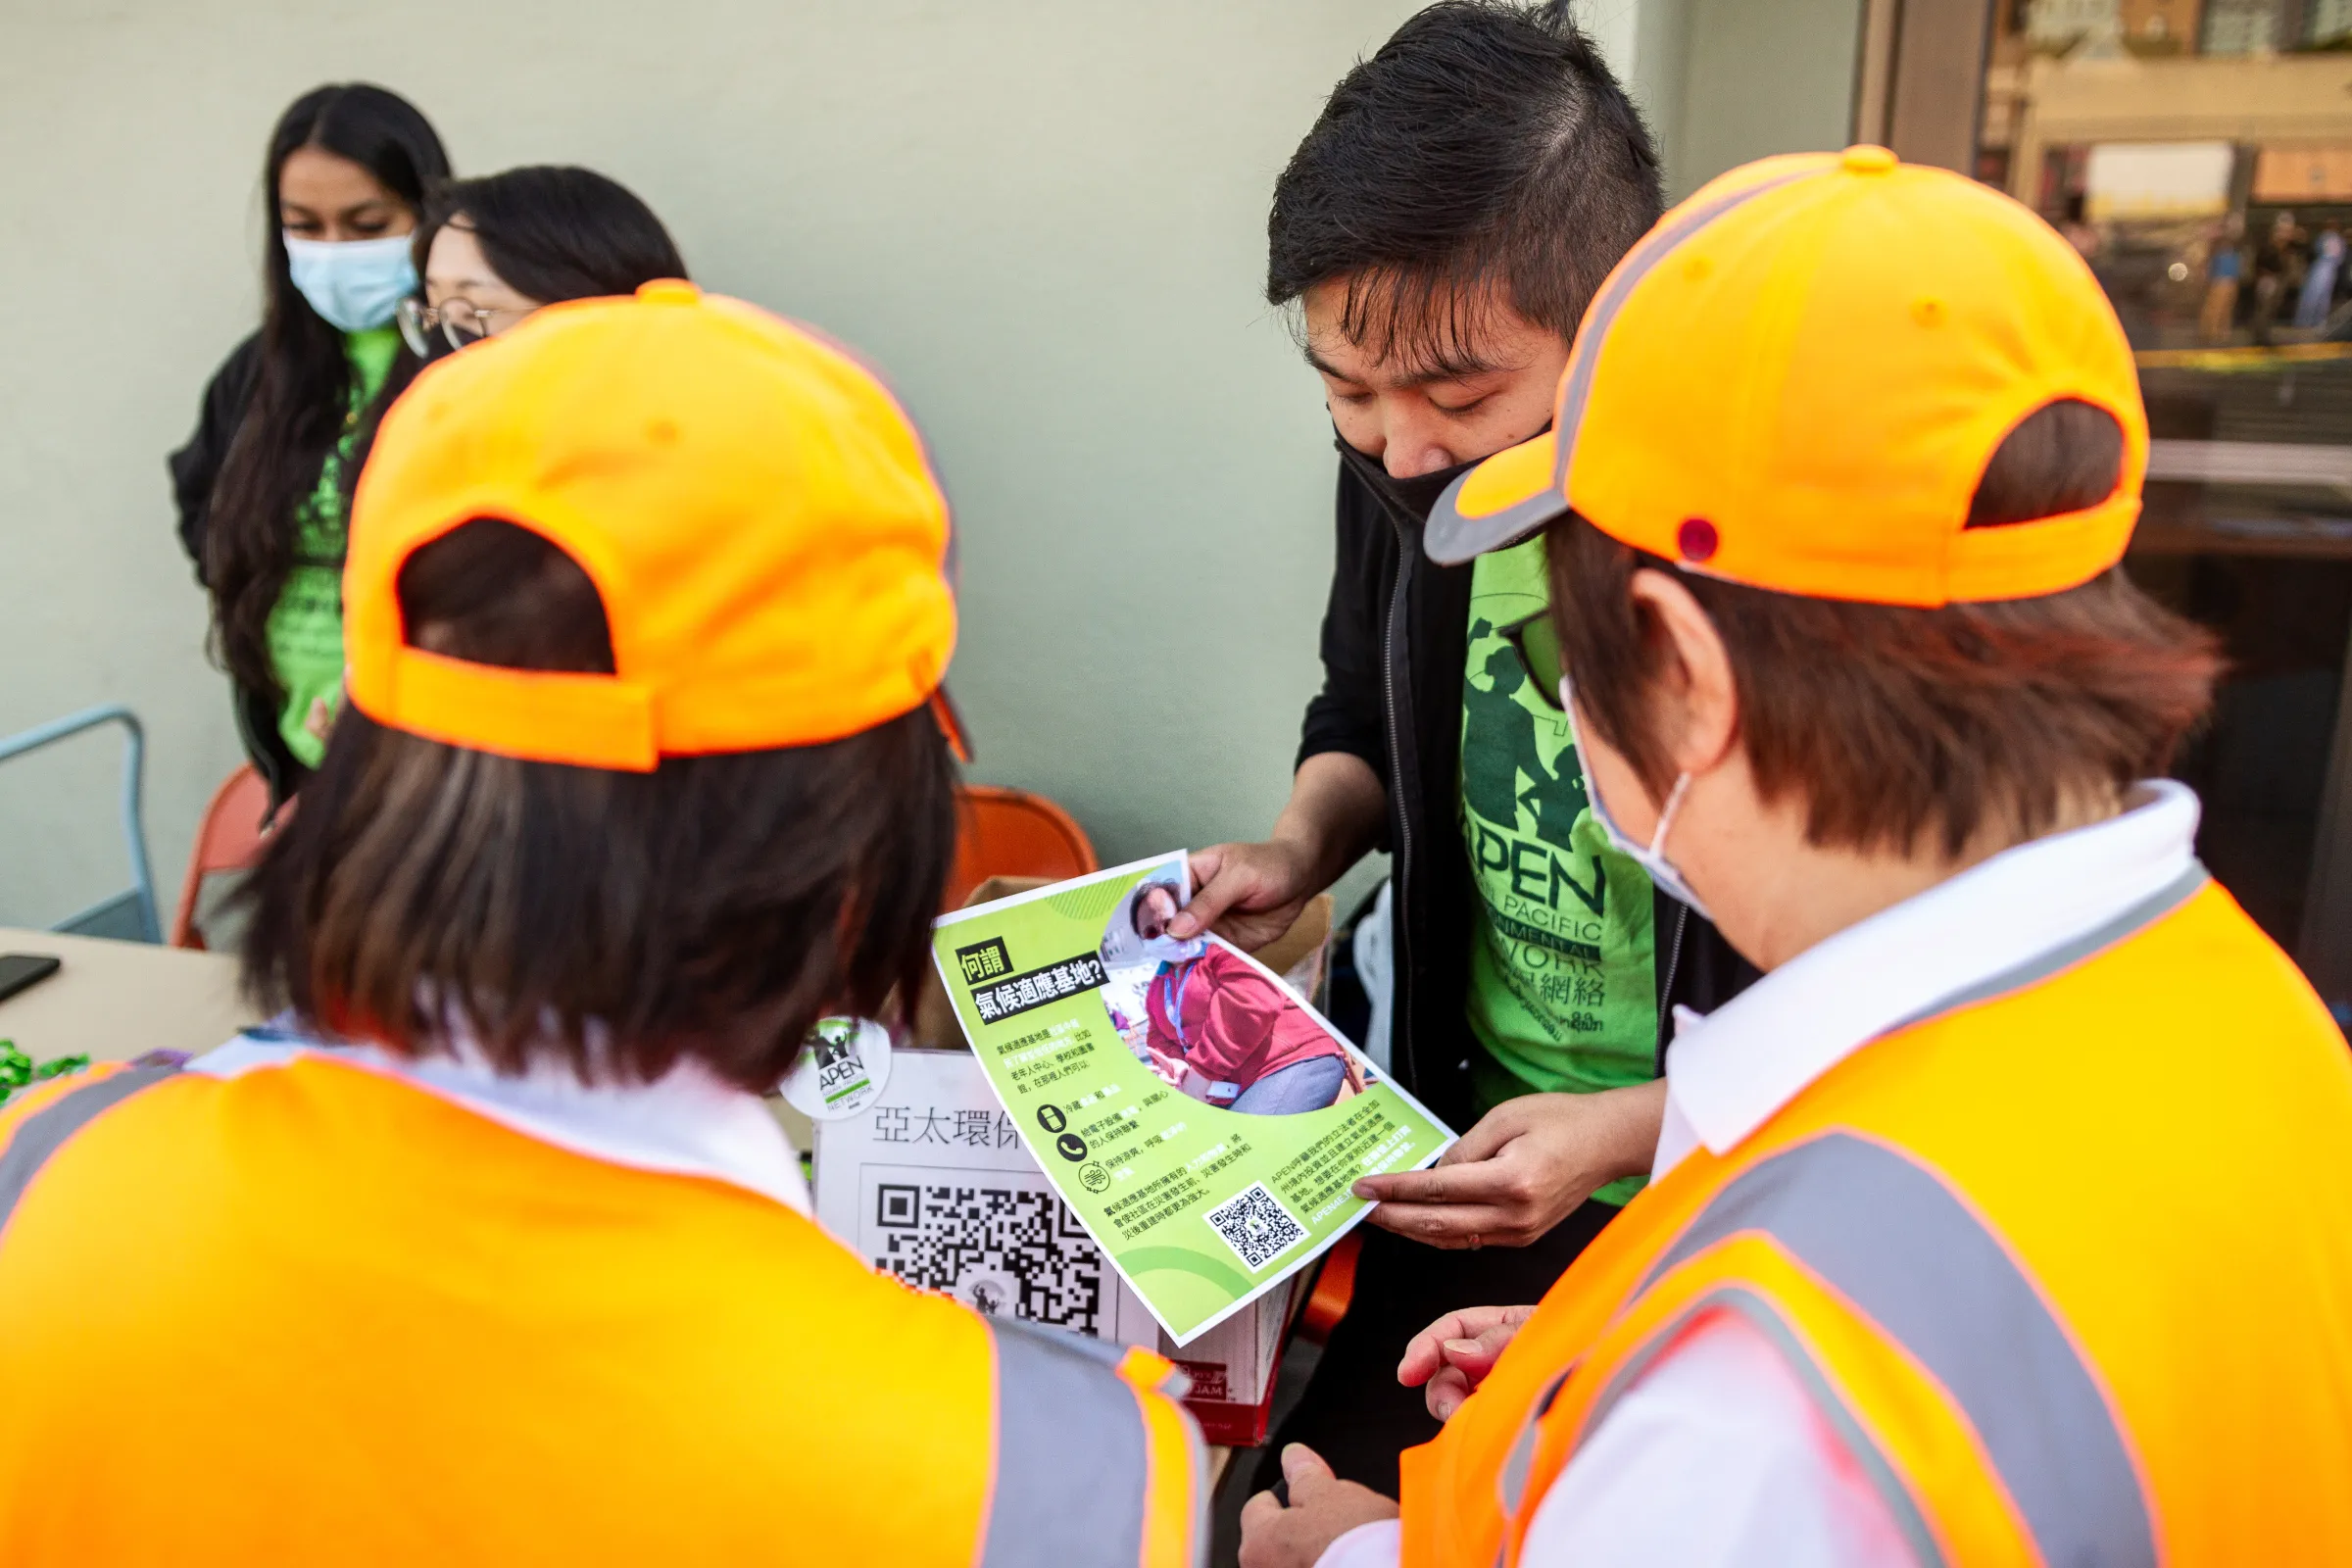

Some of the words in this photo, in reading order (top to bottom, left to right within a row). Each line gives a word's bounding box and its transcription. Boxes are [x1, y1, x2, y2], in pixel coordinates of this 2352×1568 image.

[1503, 894, 1601, 941] PACIFIC
[961, 945, 1004, 981] 何謂
[975, 959, 1102, 1019] 氣候適應基地?
[1529, 971, 1605, 1007] 網絡
[819, 1056, 864, 1091] APEN
[827, 1085, 874, 1112] NETWORK
